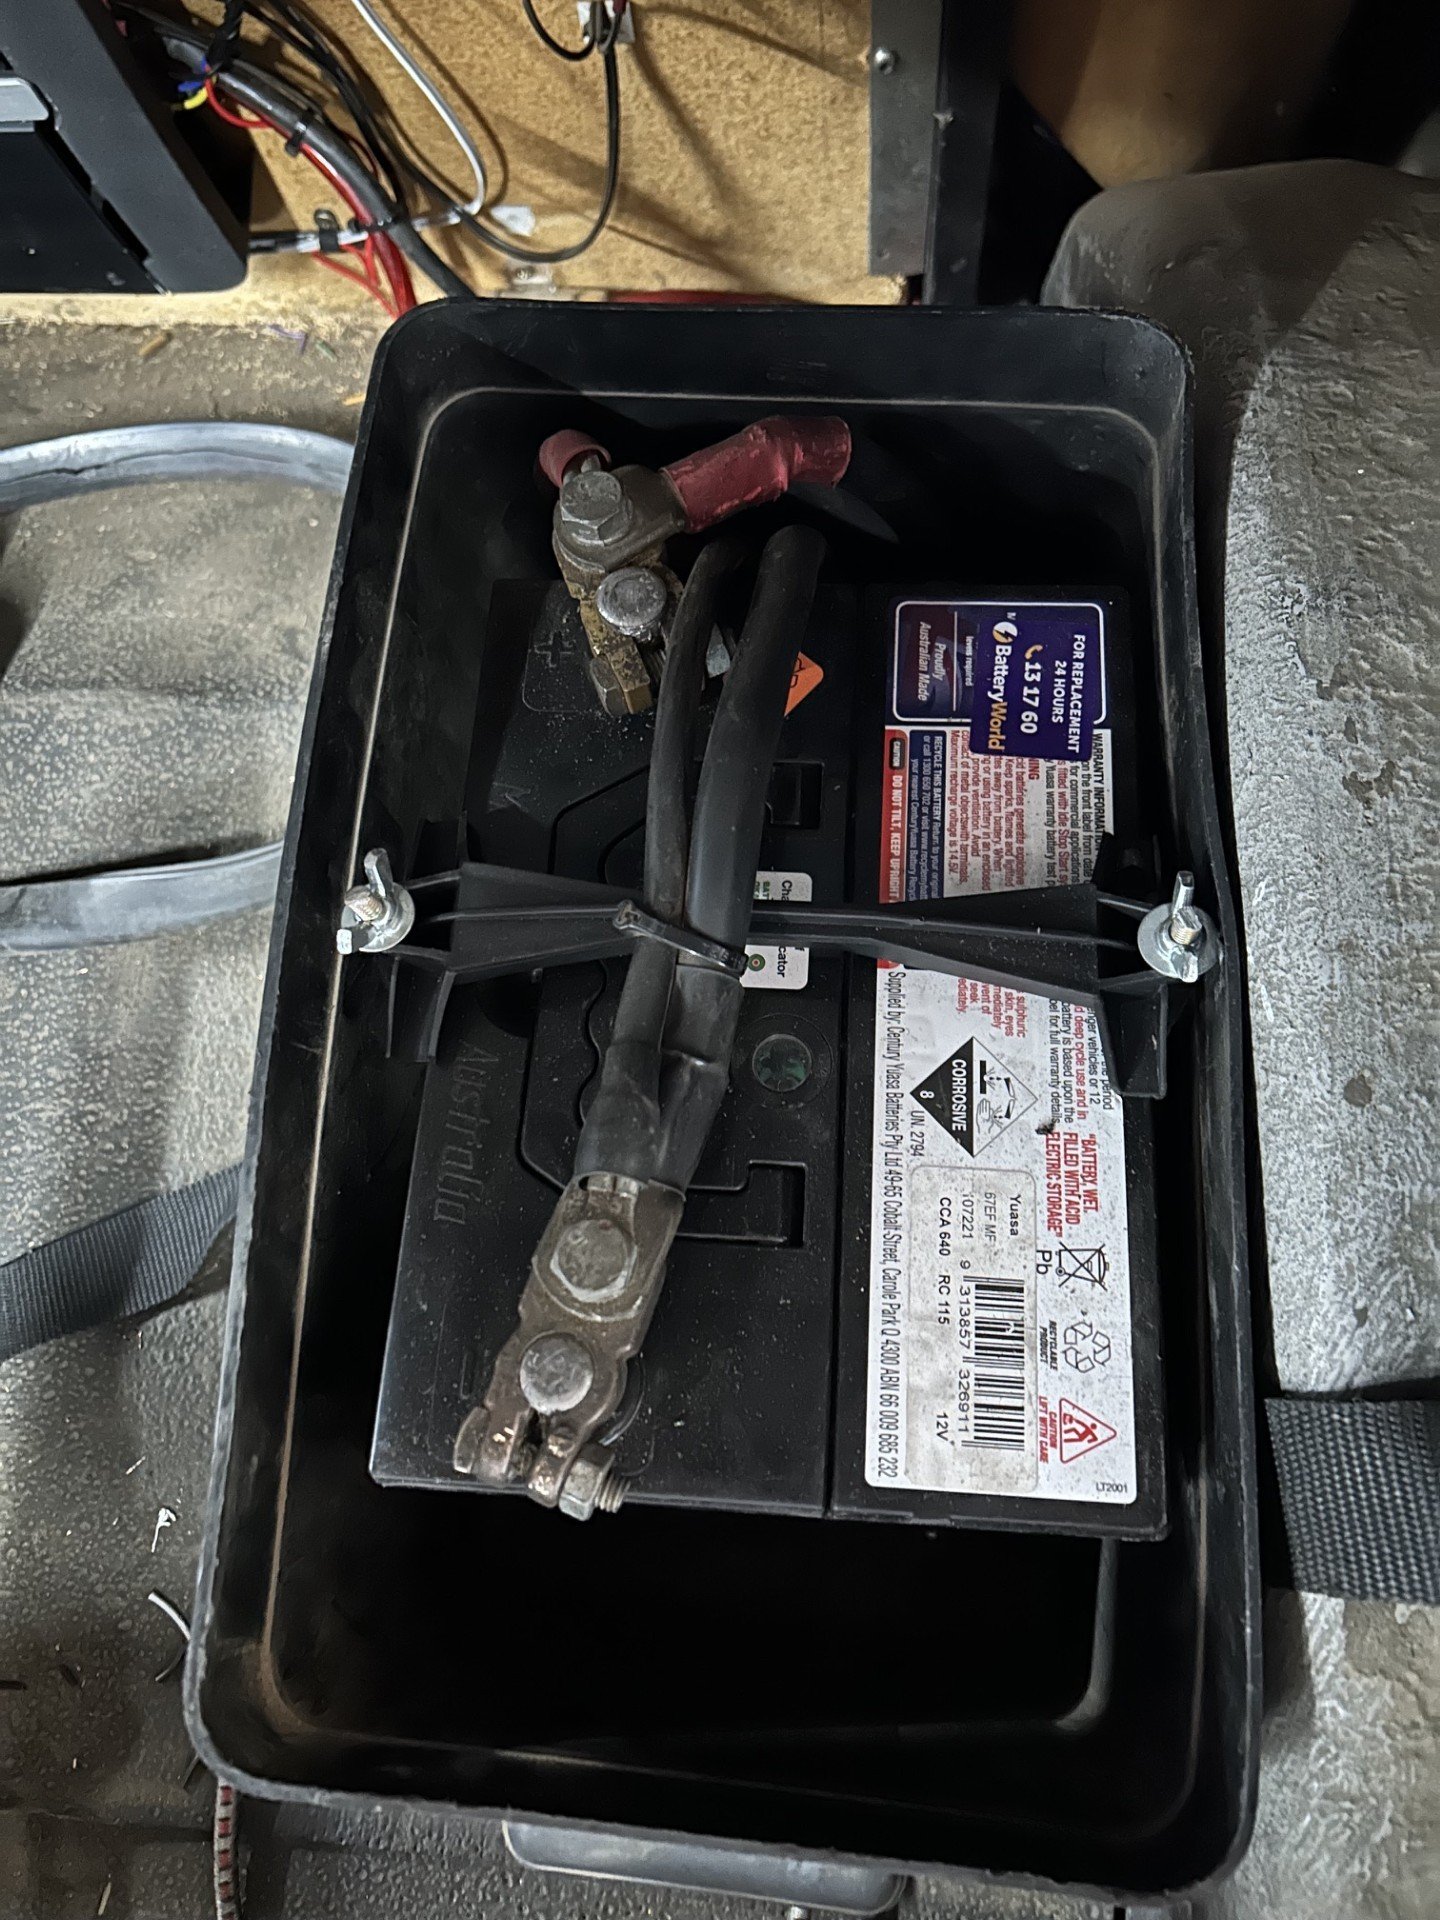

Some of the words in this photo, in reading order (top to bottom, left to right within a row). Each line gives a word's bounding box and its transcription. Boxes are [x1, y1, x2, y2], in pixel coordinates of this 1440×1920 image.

[918, 622, 932, 671] Australian
[1073, 634, 1086, 659] FOR
[932, 642, 946, 681] Proudly
[963, 658, 974, 686] required
[1024, 662, 1041, 682] 13
[1054, 660, 1066, 675] 24
[918, 673, 930, 701] Made
[1023, 686, 1039, 708] 17
[1052, 678, 1065, 723] HOURS
[1067, 662, 1084, 753] REPLACEMENT
[1020, 710, 1038, 733] 60
[893, 741, 901, 768] CAUTION
[923, 744, 932, 756] call
[934, 736, 942, 769] RECYCLE
[950, 730, 960, 769] Maximum
[960, 730, 970, 759] contact
[922, 758, 930, 774] 1300
[961, 761, 969, 769] of
[1004, 758, 1014, 778] Keep
[1093, 733, 1104, 785] WARRANTY
[892, 775, 902, 788] DO
[934, 770, 942, 788] THIS
[961, 771, 970, 793] metal
[970, 758, 980, 788] provide
[992, 772, 1002, 792] away
[1046, 765, 1056, 788] Yuasa
[1058, 768, 1068, 788] fitted
[1070, 766, 1080, 778] for
[1083, 774, 1092, 787] the
[891, 790, 902, 808] NOT
[911, 775, 919, 800] nearest
[922, 792, 930, 806] 702
[948, 770, 959, 806] recharge
[980, 778, 992, 798] using
[1016, 771, 1026, 806] batteries
[932, 788, 942, 821] BATTERY
[994, 794, 1003, 814] from
[1044, 792, 1056, 828] warranty
[1058, 792, 1068, 810] with
[1070, 780, 1080, 828] commercial
[1083, 790, 1093, 810] front
[922, 816, 930, 830] visit
[947, 808, 958, 838] voltage
[980, 801, 992, 830] battery
[1005, 812, 1014, 840] flames
[1014, 808, 1026, 844] generate
[1083, 812, 1093, 832] label
[890, 833, 900, 856] KEEP
[950, 840, 958, 848] is
[972, 834, 980, 857] Avoid
[983, 832, 992, 840] in
[983, 842, 990, 852] an
[1044, 830, 1057, 860] battery
[1056, 829, 1069, 849] Stop
[1083, 834, 1093, 855] from
[994, 848, 1002, 872] When
[1005, 842, 1014, 856] and
[908, 850, 918, 875] Battery
[930, 856, 938, 870] your
[982, 854, 992, 890] enclosed
[1014, 846, 1026, 885] explosive
[1046, 862, 1056, 878] test
[1058, 852, 1069, 873] Start
[1083, 858, 1094, 878] date
[889, 858, 900, 896] UPRIGHT
[885, 972, 906, 1008] Supplied
[982, 1006, 992, 1015] of
[1004, 992, 1014, 1013] skin,
[883, 1011, 906, 1025] by:
[1002, 1016, 1012, 1037] eyes
[1014, 996, 1028, 1038] sulphuric
[1072, 1016, 1084, 1040] deep
[880, 1027, 906, 1060] Century
[1050, 1030, 1060, 1044] full
[1062, 1037, 1072, 1046] is
[1062, 1048, 1074, 1077] based
[1072, 1042, 1086, 1066] cycle
[1088, 1036, 1100, 1076] vehicles
[886, 1064, 904, 1089] Yuasa
[1048, 1047, 1061, 1088] warranty
[1076, 1068, 1085, 1086] use
[920, 1090, 935, 1099] 8
[1062, 1080, 1072, 1104] upon
[1090, 1078, 1098, 1088] or
[951, 1059, 968, 1131] CORROSIVE
[1076, 1088, 1086, 1108] and
[1090, 1092, 1100, 1104] 12
[884, 1092, 903, 1132] Batteries
[1064, 1107, 1074, 1124] the
[1077, 1110, 1088, 1120] in
[880, 1134, 903, 1149] Pty
[910, 1131, 924, 1156] 2794
[1064, 1132, 1078, 1166] FILLED
[884, 1152, 902, 1167] Ltd
[1046, 1132, 1061, 1180] ELECTRIC
[884, 1169, 902, 1198] 49-65
[1064, 1170, 1080, 1196] WITH
[938, 1197, 951, 1227] CCA
[1010, 1194, 1022, 1236] Yuasa
[1066, 1199, 1080, 1225] ACID
[938, 1231, 951, 1257] 640
[984, 1224, 996, 1242] MF
[960, 1260, 970, 1269] 9
[1036, 1250, 1052, 1275] Pb
[882, 1268, 902, 1300] Carole
[938, 1274, 950, 1295] RC
[881, 1302, 901, 1326] Park
[938, 1301, 950, 1325] 115
[959, 1286, 970, 1349] 313857
[880, 1328, 900, 1337] Q
[881, 1340, 900, 1366] 4300
[1040, 1326, 1049, 1364] PRODUCT
[1049, 1320, 1058, 1371] RECYCLABLE
[880, 1368, 900, 1390] ABN
[880, 1394, 900, 1408] 66
[958, 1370, 970, 1433] 326911
[1039, 1396, 1048, 1414] LIFT
[879, 1410, 899, 1430] 009
[936, 1412, 948, 1441] 12V
[1039, 1416, 1048, 1438] WITH
[1049, 1411, 1058, 1448] CAUTION
[878, 1434, 899, 1454] 685
[1039, 1440, 1048, 1464] CARE
[878, 1456, 898, 1478] 232
[1096, 1482, 1128, 1494] LT2001
